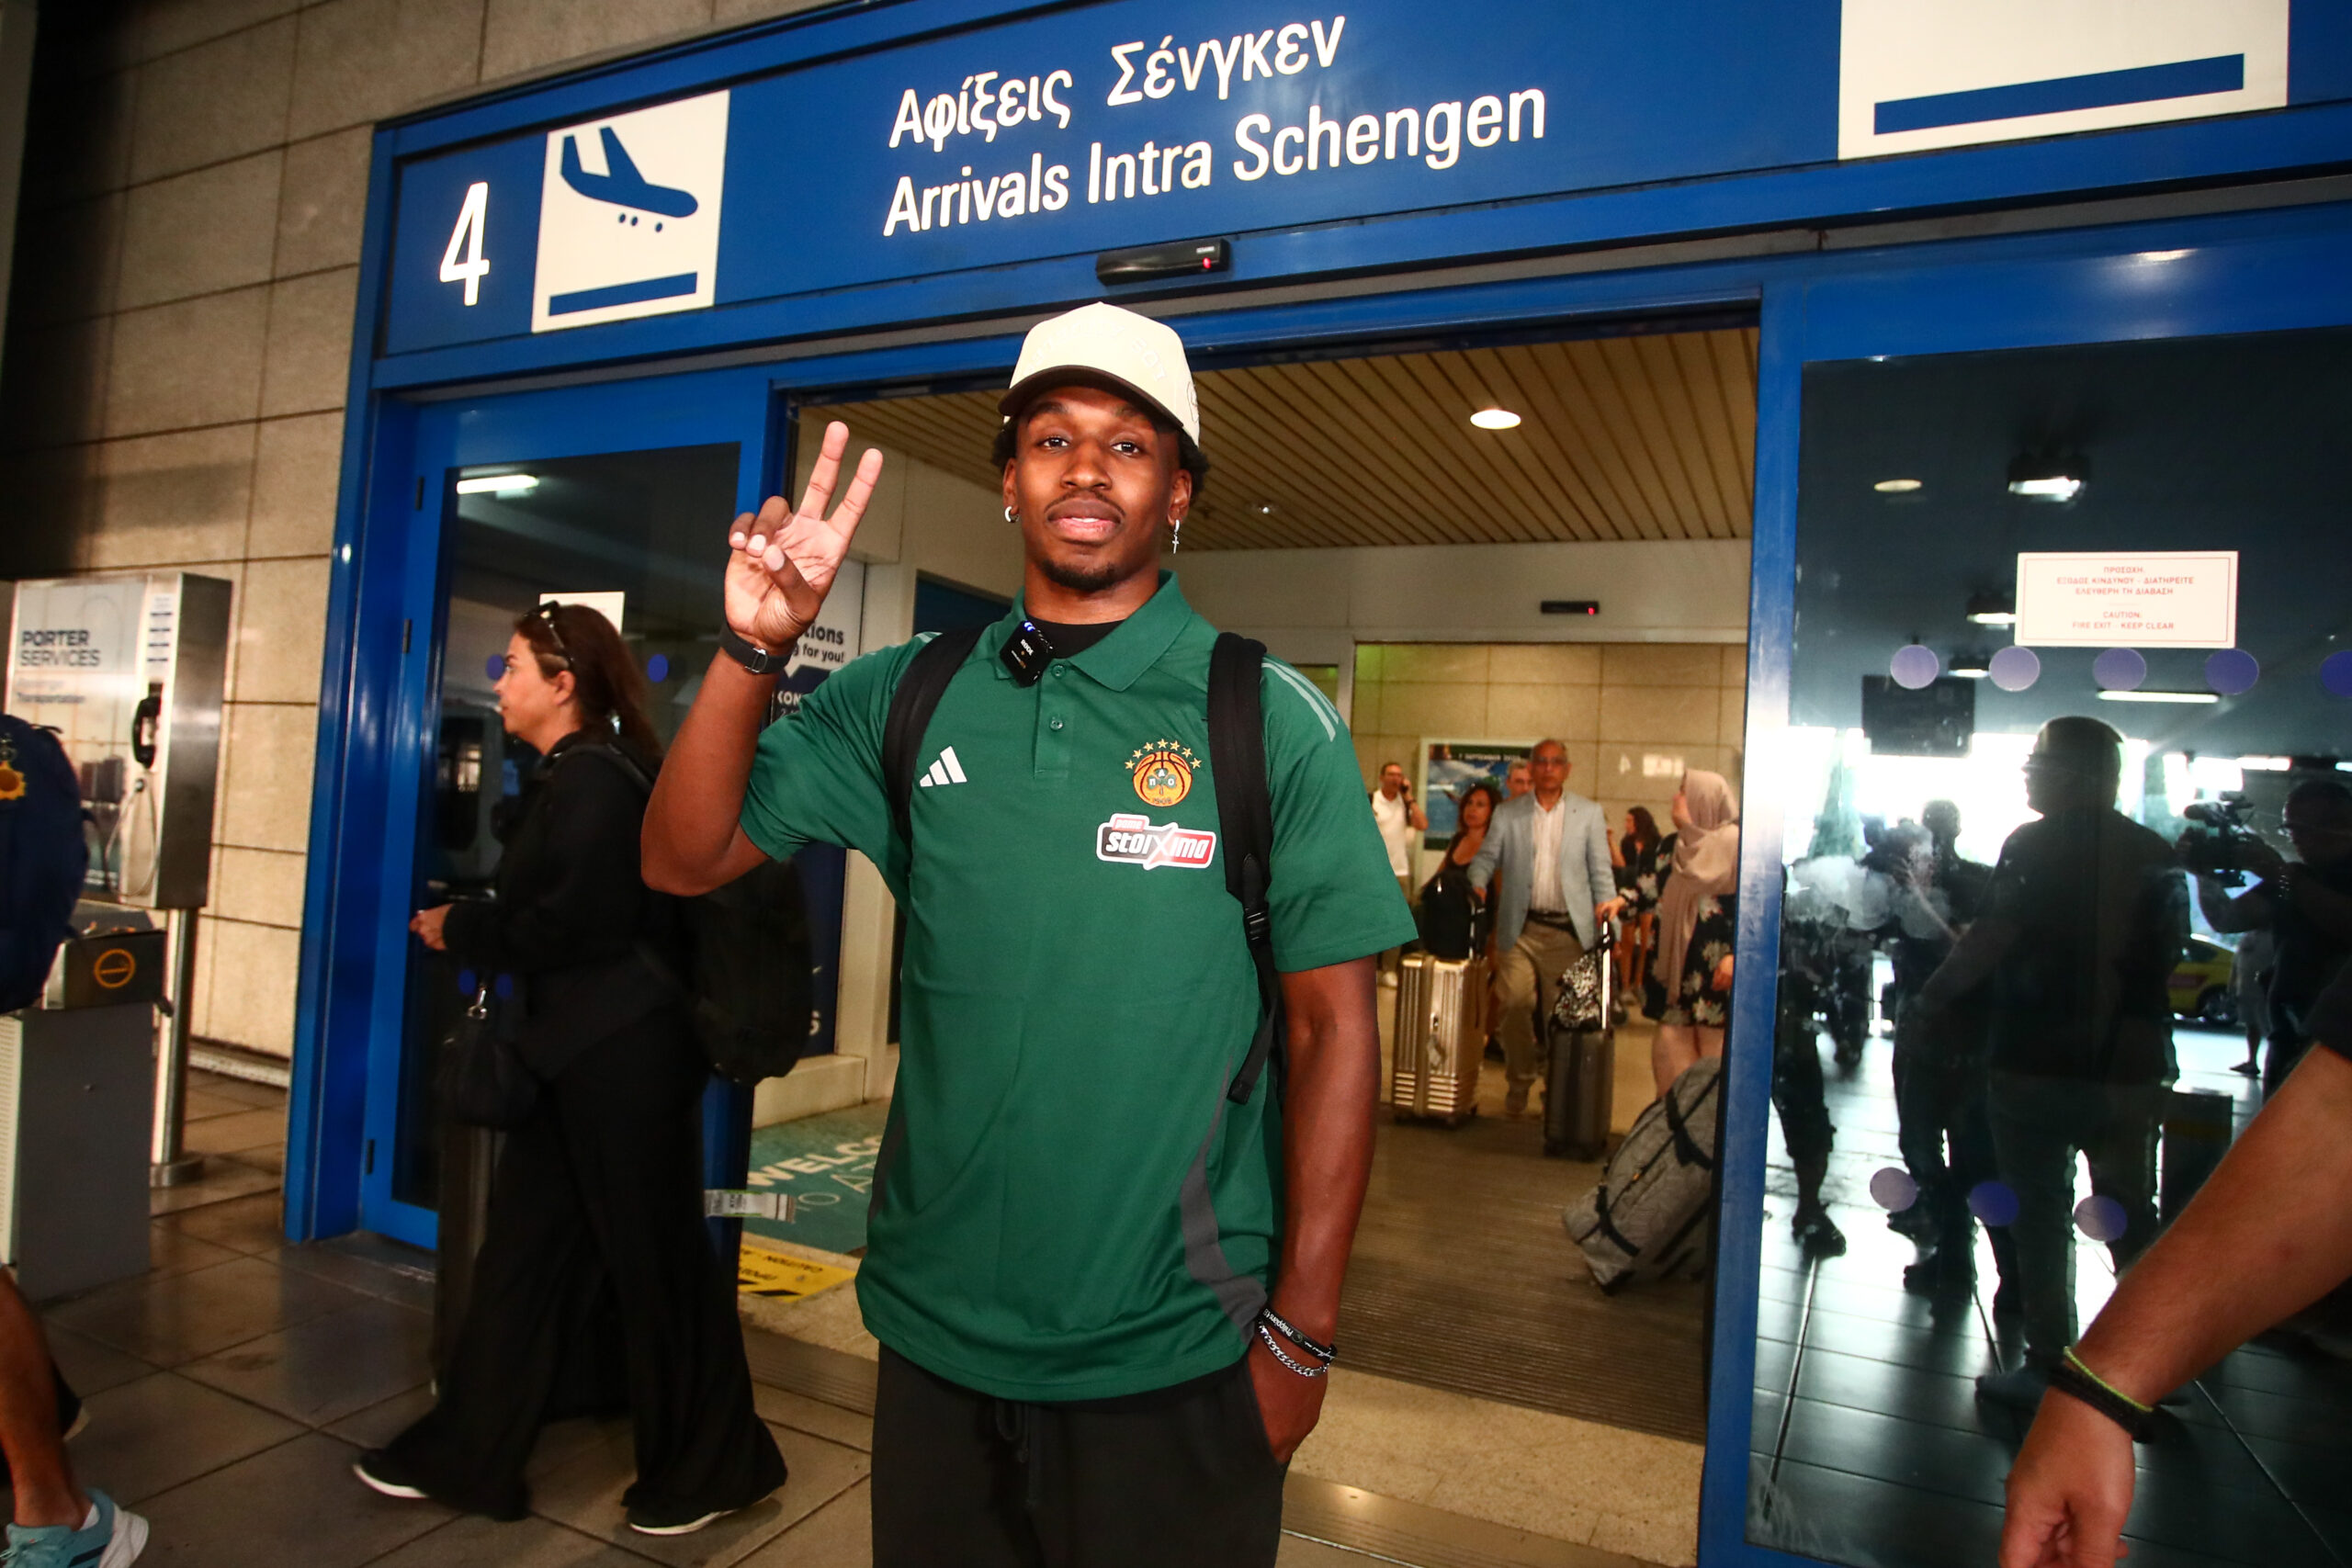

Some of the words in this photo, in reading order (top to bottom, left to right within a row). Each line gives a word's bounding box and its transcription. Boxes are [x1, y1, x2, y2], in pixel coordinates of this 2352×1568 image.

[889, 68, 1074, 152] Αφίξεις
[1107, 16, 1346, 107] Σένγκεν
[883, 152, 1069, 237] Arrivals
[1088, 140, 1213, 205] Intra
[1233, 88, 1545, 182] Schengen
[439, 182, 491, 307] 4
[2143, 576, 2195, 584] ΔΙΑΤΗΡΕΙΤΕ
[2135, 587, 2174, 595] ΔΙΑΒΑΣΗ
[2120, 622, 2143, 630] KEEP
[2145, 622, 2175, 630] CLEAR
[22, 630, 89, 646] PORTER
[20, 649, 101, 667] SERVICES
[802, 644, 820, 659] for
[821, 649, 844, 662] you!
